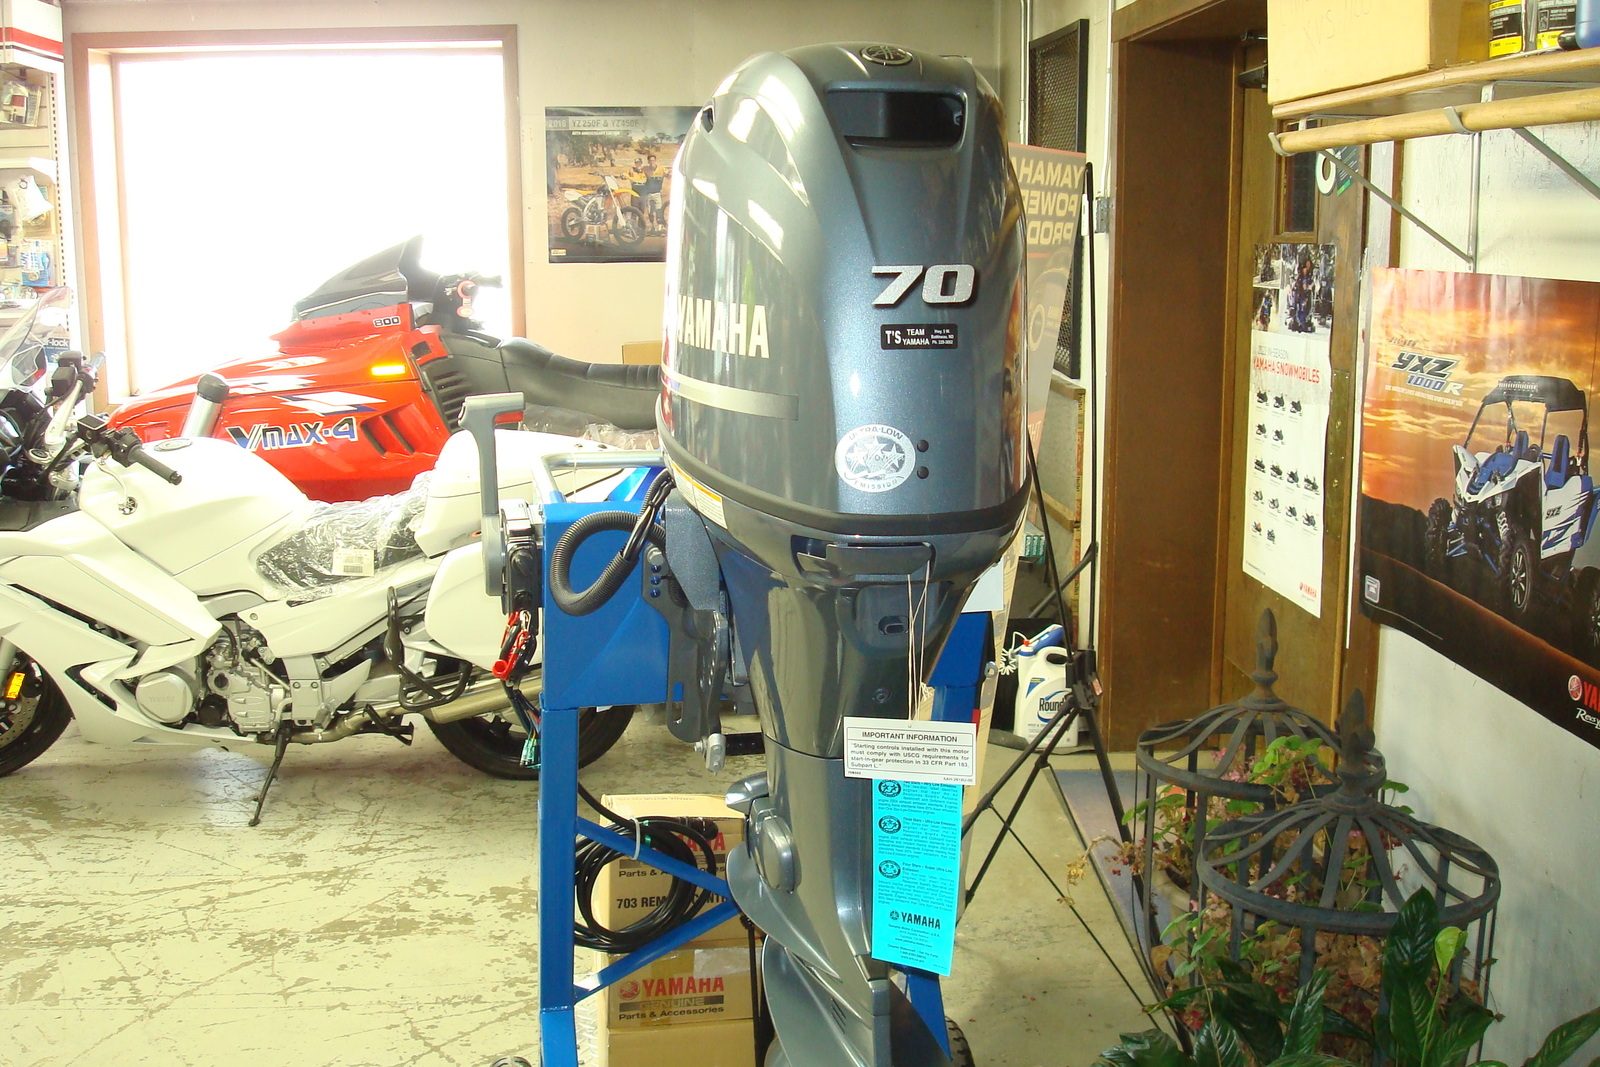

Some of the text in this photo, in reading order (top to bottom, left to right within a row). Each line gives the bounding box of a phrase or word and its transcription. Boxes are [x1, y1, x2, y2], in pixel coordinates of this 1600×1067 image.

[871, 264, 976, 305] 70
[373, 316, 400, 328] 800
[676, 294, 770, 359] YAMAHA
[885, 330, 902, 345] T'S
[906, 328, 925, 336] TEAM
[902, 338, 930, 346] YAMAHA
[1391, 351, 1458, 379] YXZ
[1276, 361, 1320, 384] SNOWMOBILES
[862, 731, 957, 743] IMPORTANT INFORMATION
[618, 870, 647, 878] Parts
[616, 896, 667, 909] 703 REM
[901, 911, 941, 930] YAMAHA
[642, 976, 724, 997] YAMAHA
[618, 1012, 647, 1020] Parts
[660, 1006, 725, 1017] Accessories
